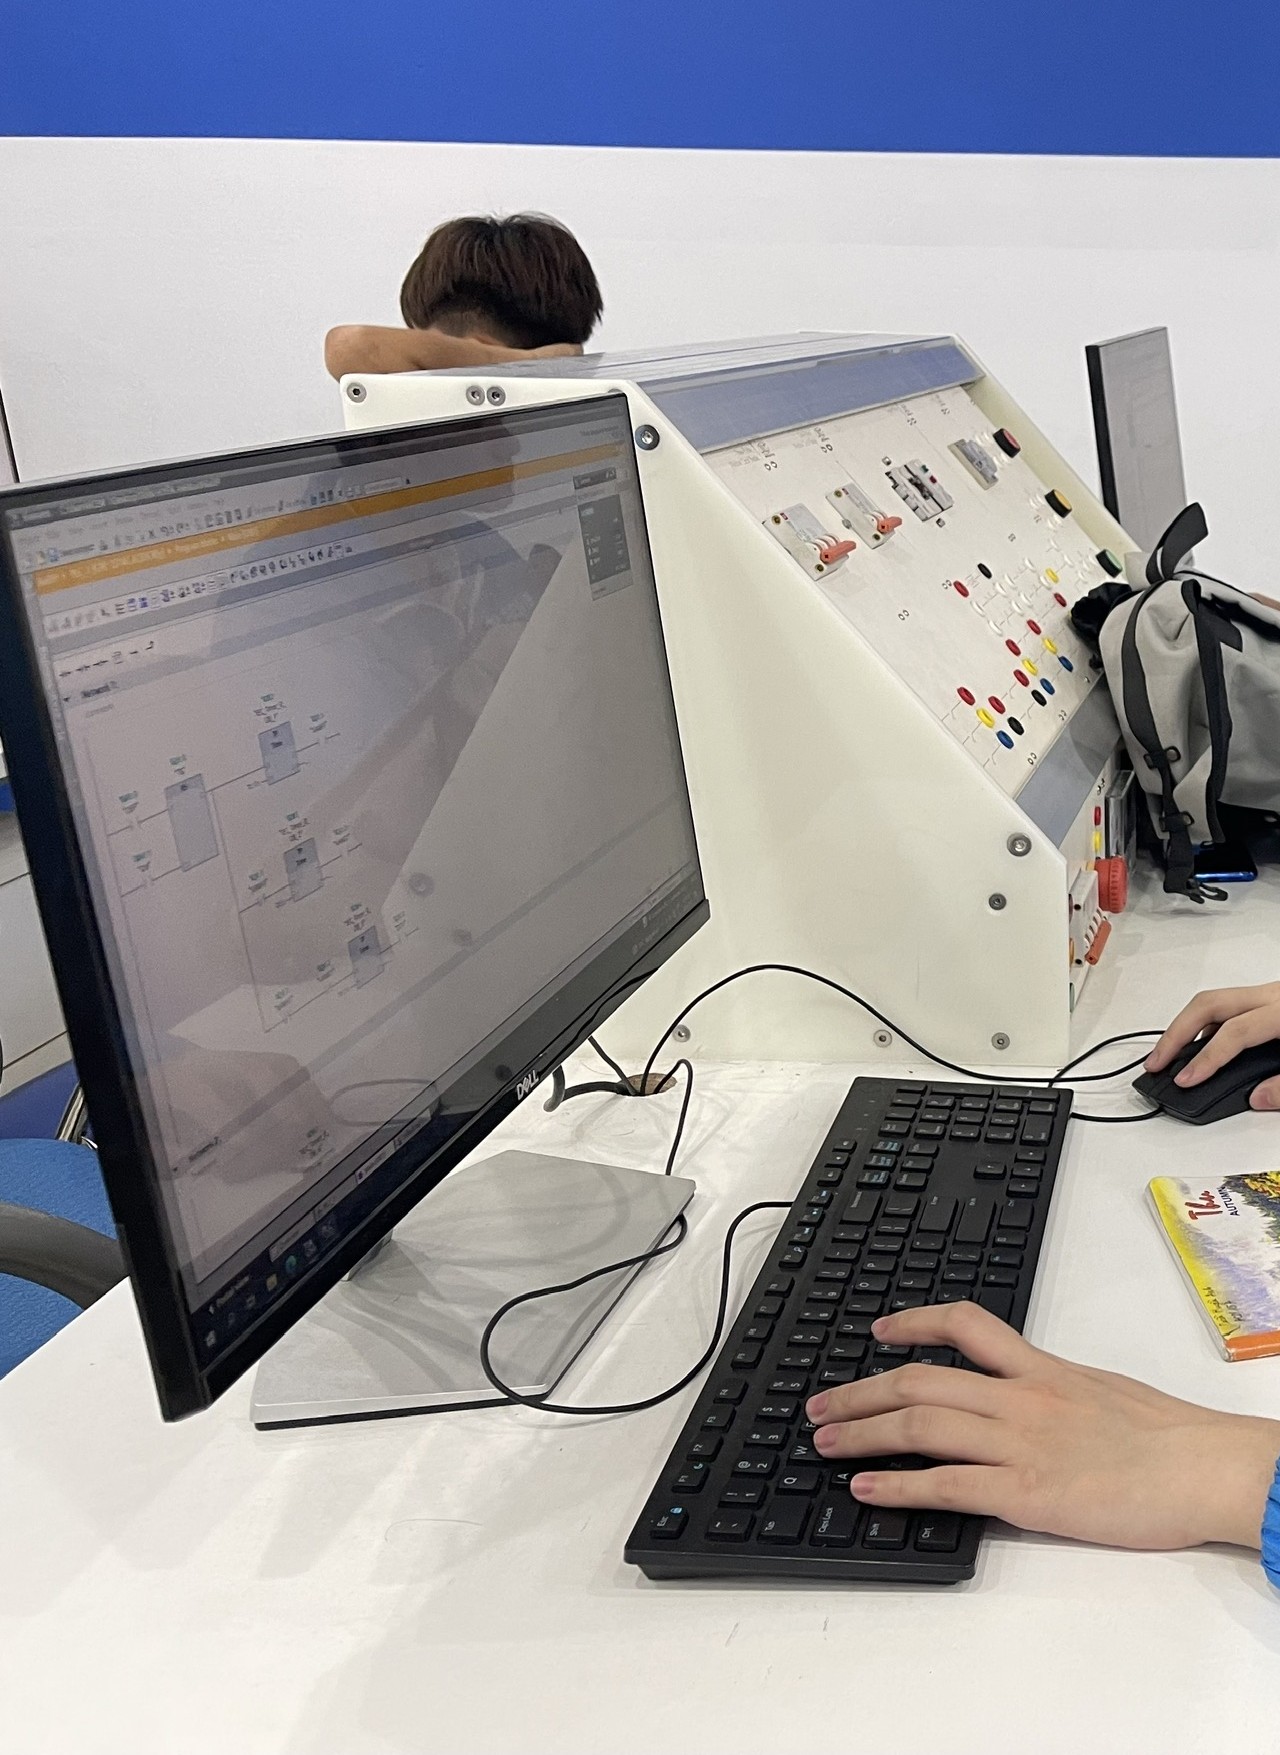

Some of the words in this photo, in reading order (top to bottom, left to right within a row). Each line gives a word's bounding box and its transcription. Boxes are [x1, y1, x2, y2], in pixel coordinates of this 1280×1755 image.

[516, 1069, 540, 1101] DELL
[1216, 1186, 1240, 1217] AUTUMN
[794, 1445, 808, 1456] W
[738, 1460, 751, 1470] @
[783, 1476, 798, 1485] Q
[837, 1472, 850, 1480] A
[869, 1523, 881, 1537] Shift
[921, 1526, 934, 1539] Ctrl
